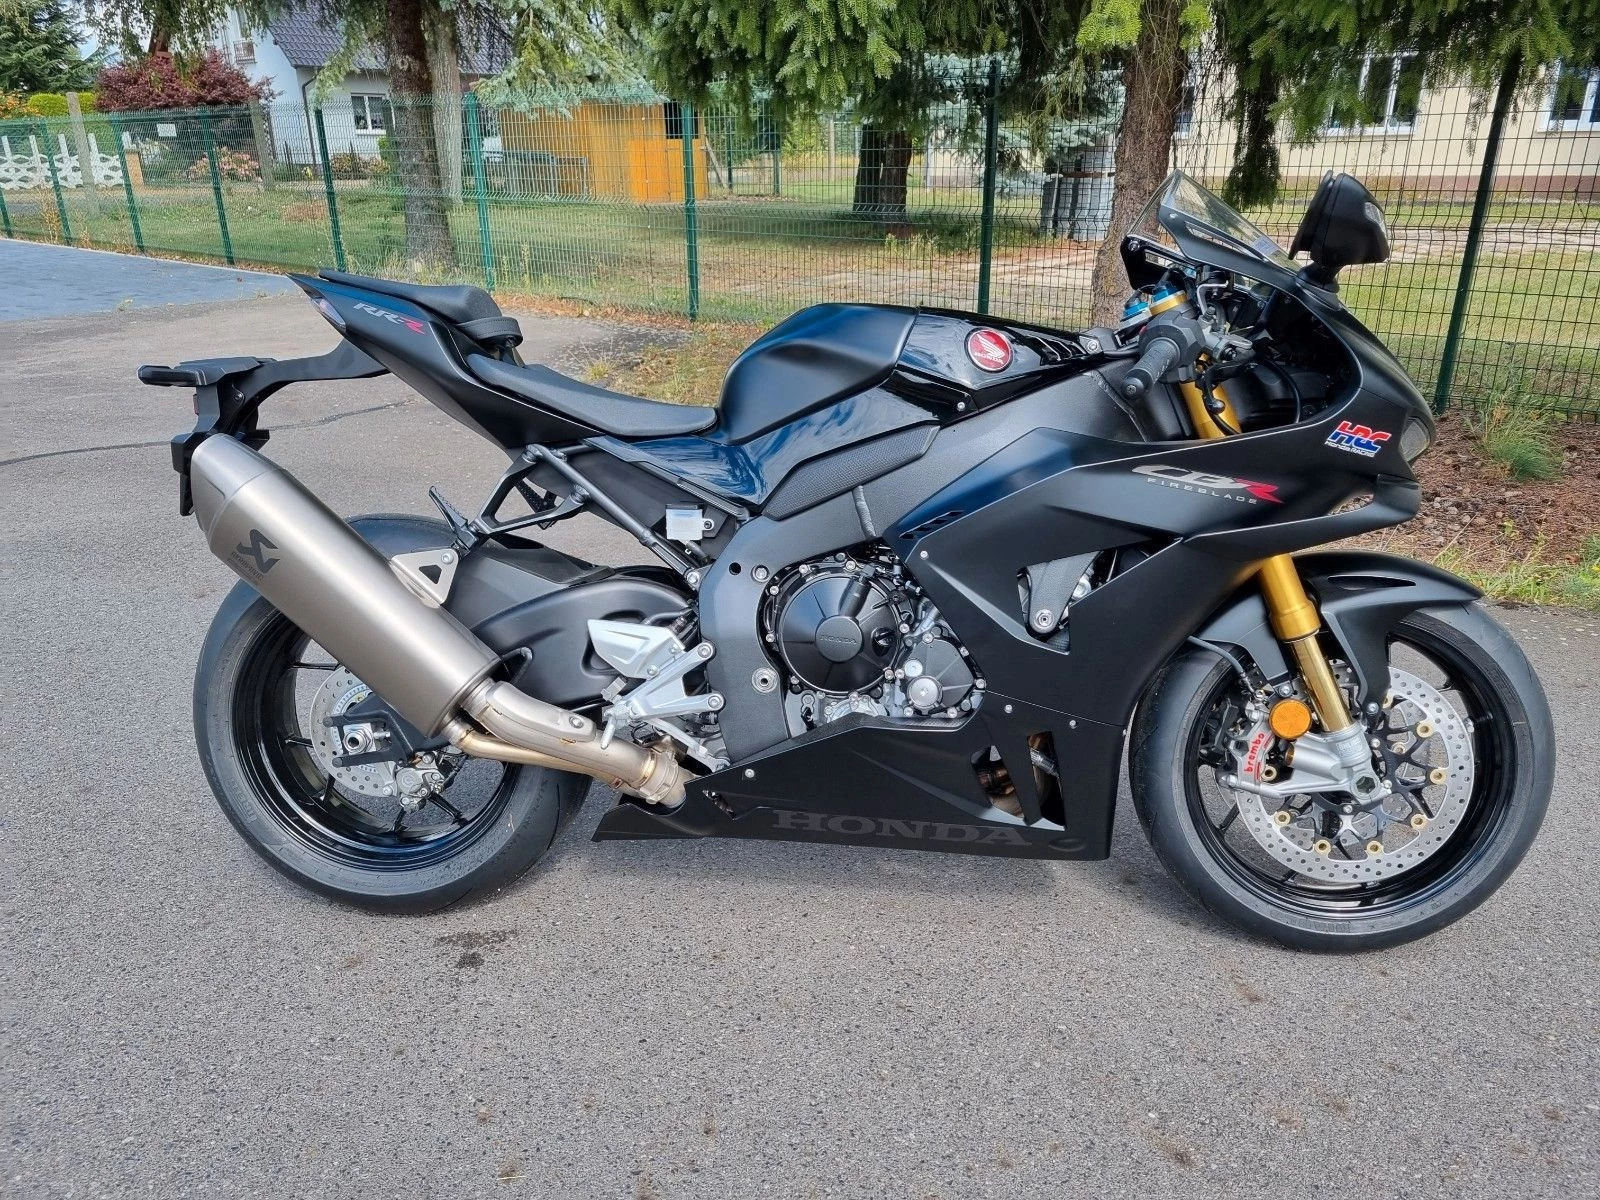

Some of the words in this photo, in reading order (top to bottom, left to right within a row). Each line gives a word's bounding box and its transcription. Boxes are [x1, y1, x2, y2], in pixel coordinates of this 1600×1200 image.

[1327, 420, 1392, 453] HRC
[1131, 464, 1284, 504] CBR
[1146, 477, 1258, 506] FIREBLADE
[819, 634, 858, 646] HONDA
[1243, 733, 1265, 773] brembo
[772, 809, 1033, 846] HONDA
